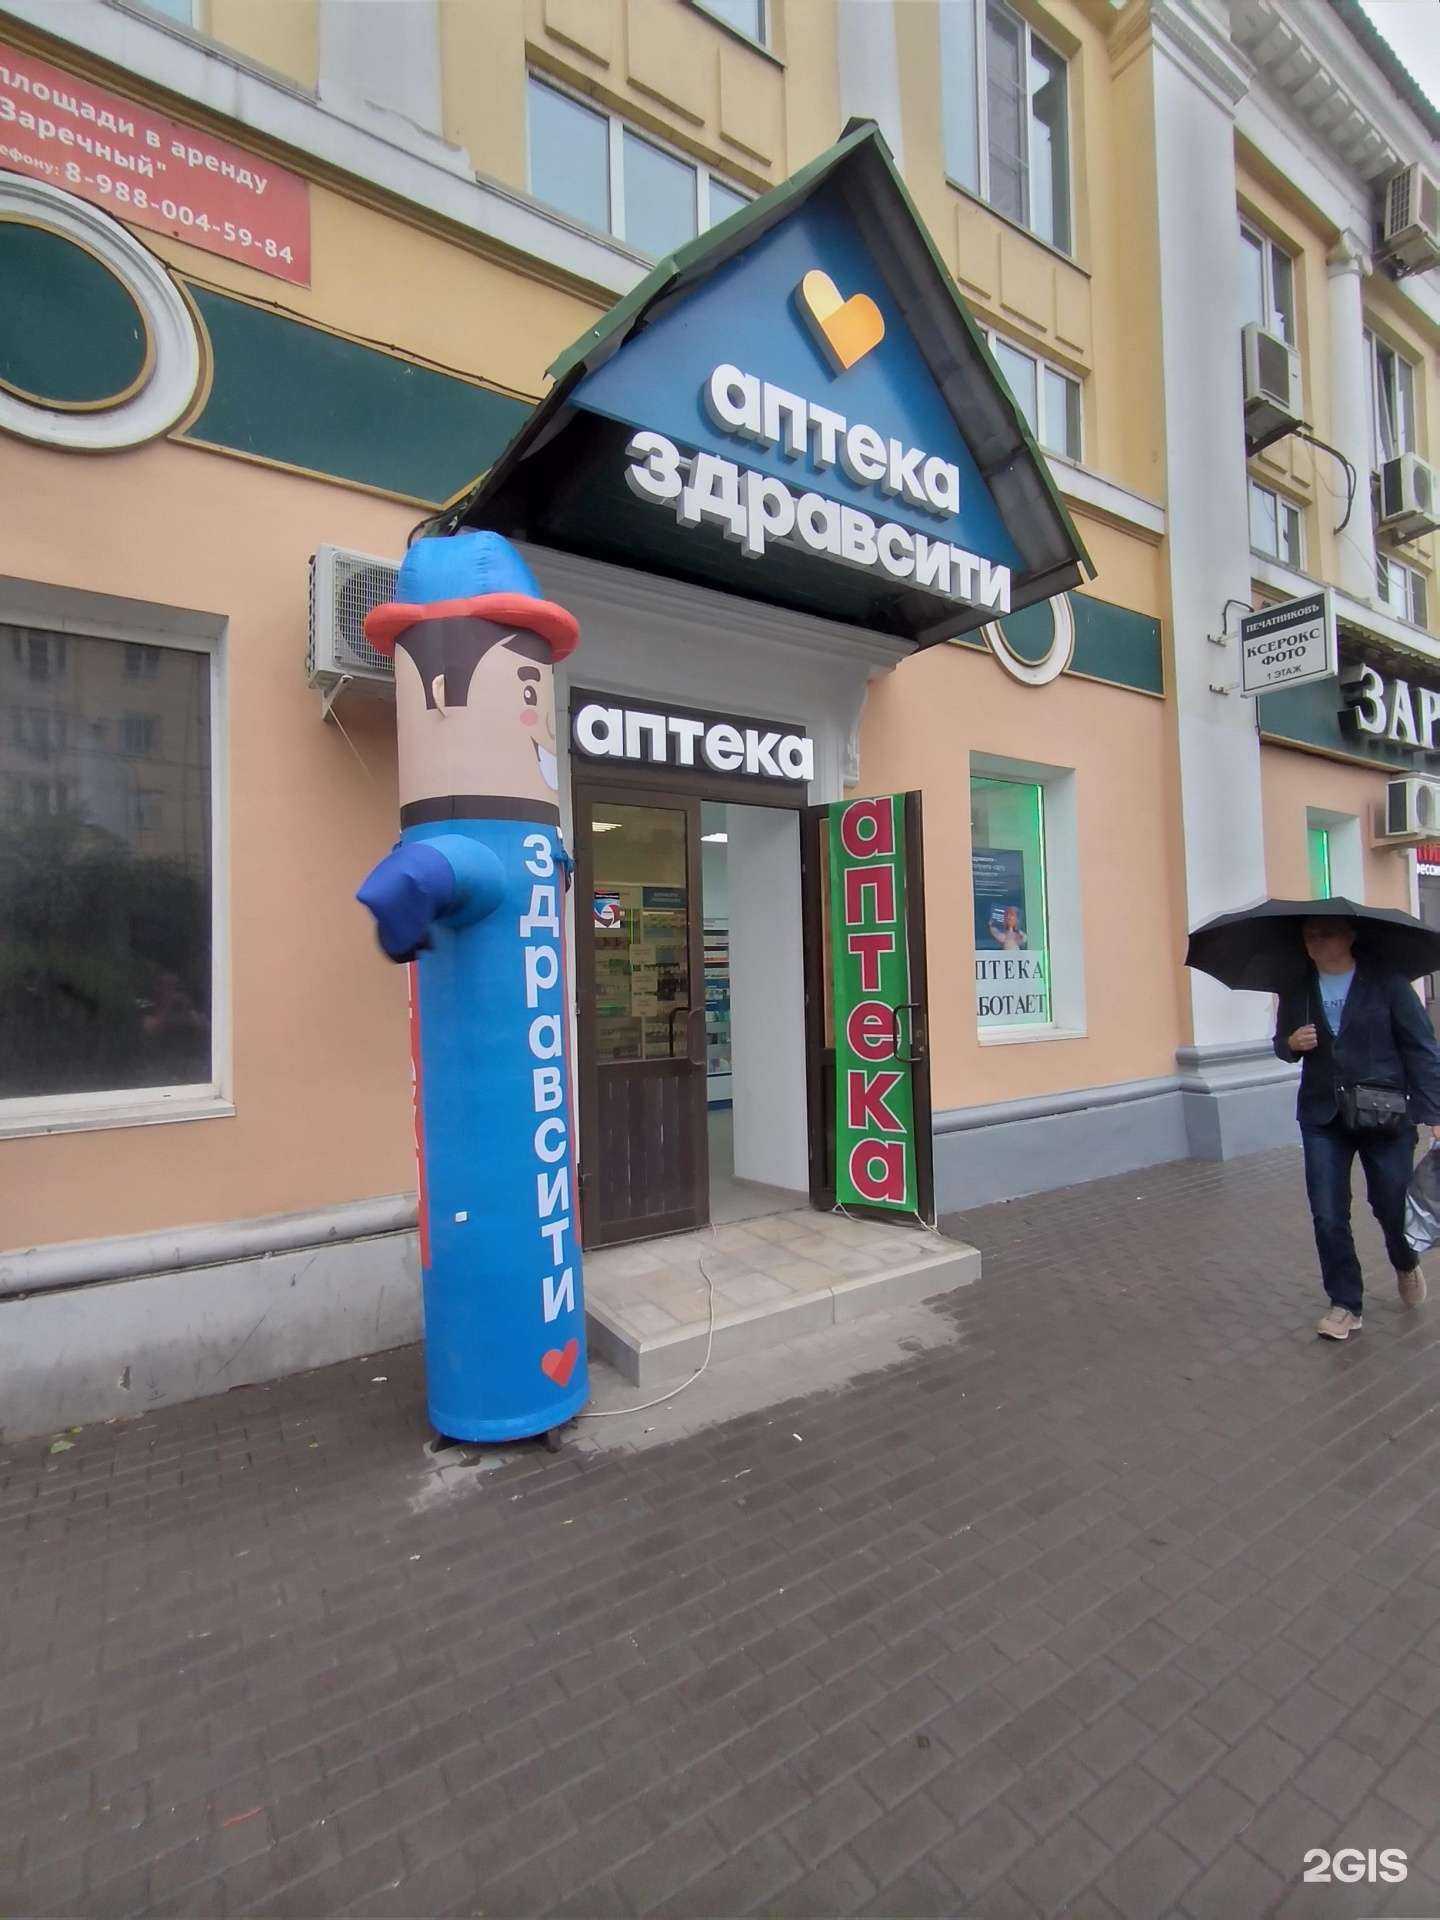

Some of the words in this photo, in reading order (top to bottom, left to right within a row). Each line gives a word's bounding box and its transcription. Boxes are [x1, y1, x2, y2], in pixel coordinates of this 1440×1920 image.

[145, 129, 161, 149] в
[171, 140, 269, 195] аренду
[64, 161, 294, 265] 8-988-004-59-84
[706, 363, 961, 519] аптека
[1246, 604, 1320, 633] ПЕЧАТНИКОВЪ
[1247, 628, 1321, 658] КСЕРОКС
[1261, 645, 1306, 665] ФОТО
[1274, 665, 1303, 679] ЭТАЖ
[1353, 662, 1440, 750] ЗАР
[575, 703, 815, 783] аптека
[840, 796, 909, 1204] аптека
[976, 994, 1047, 1017] БОТАЕТ
